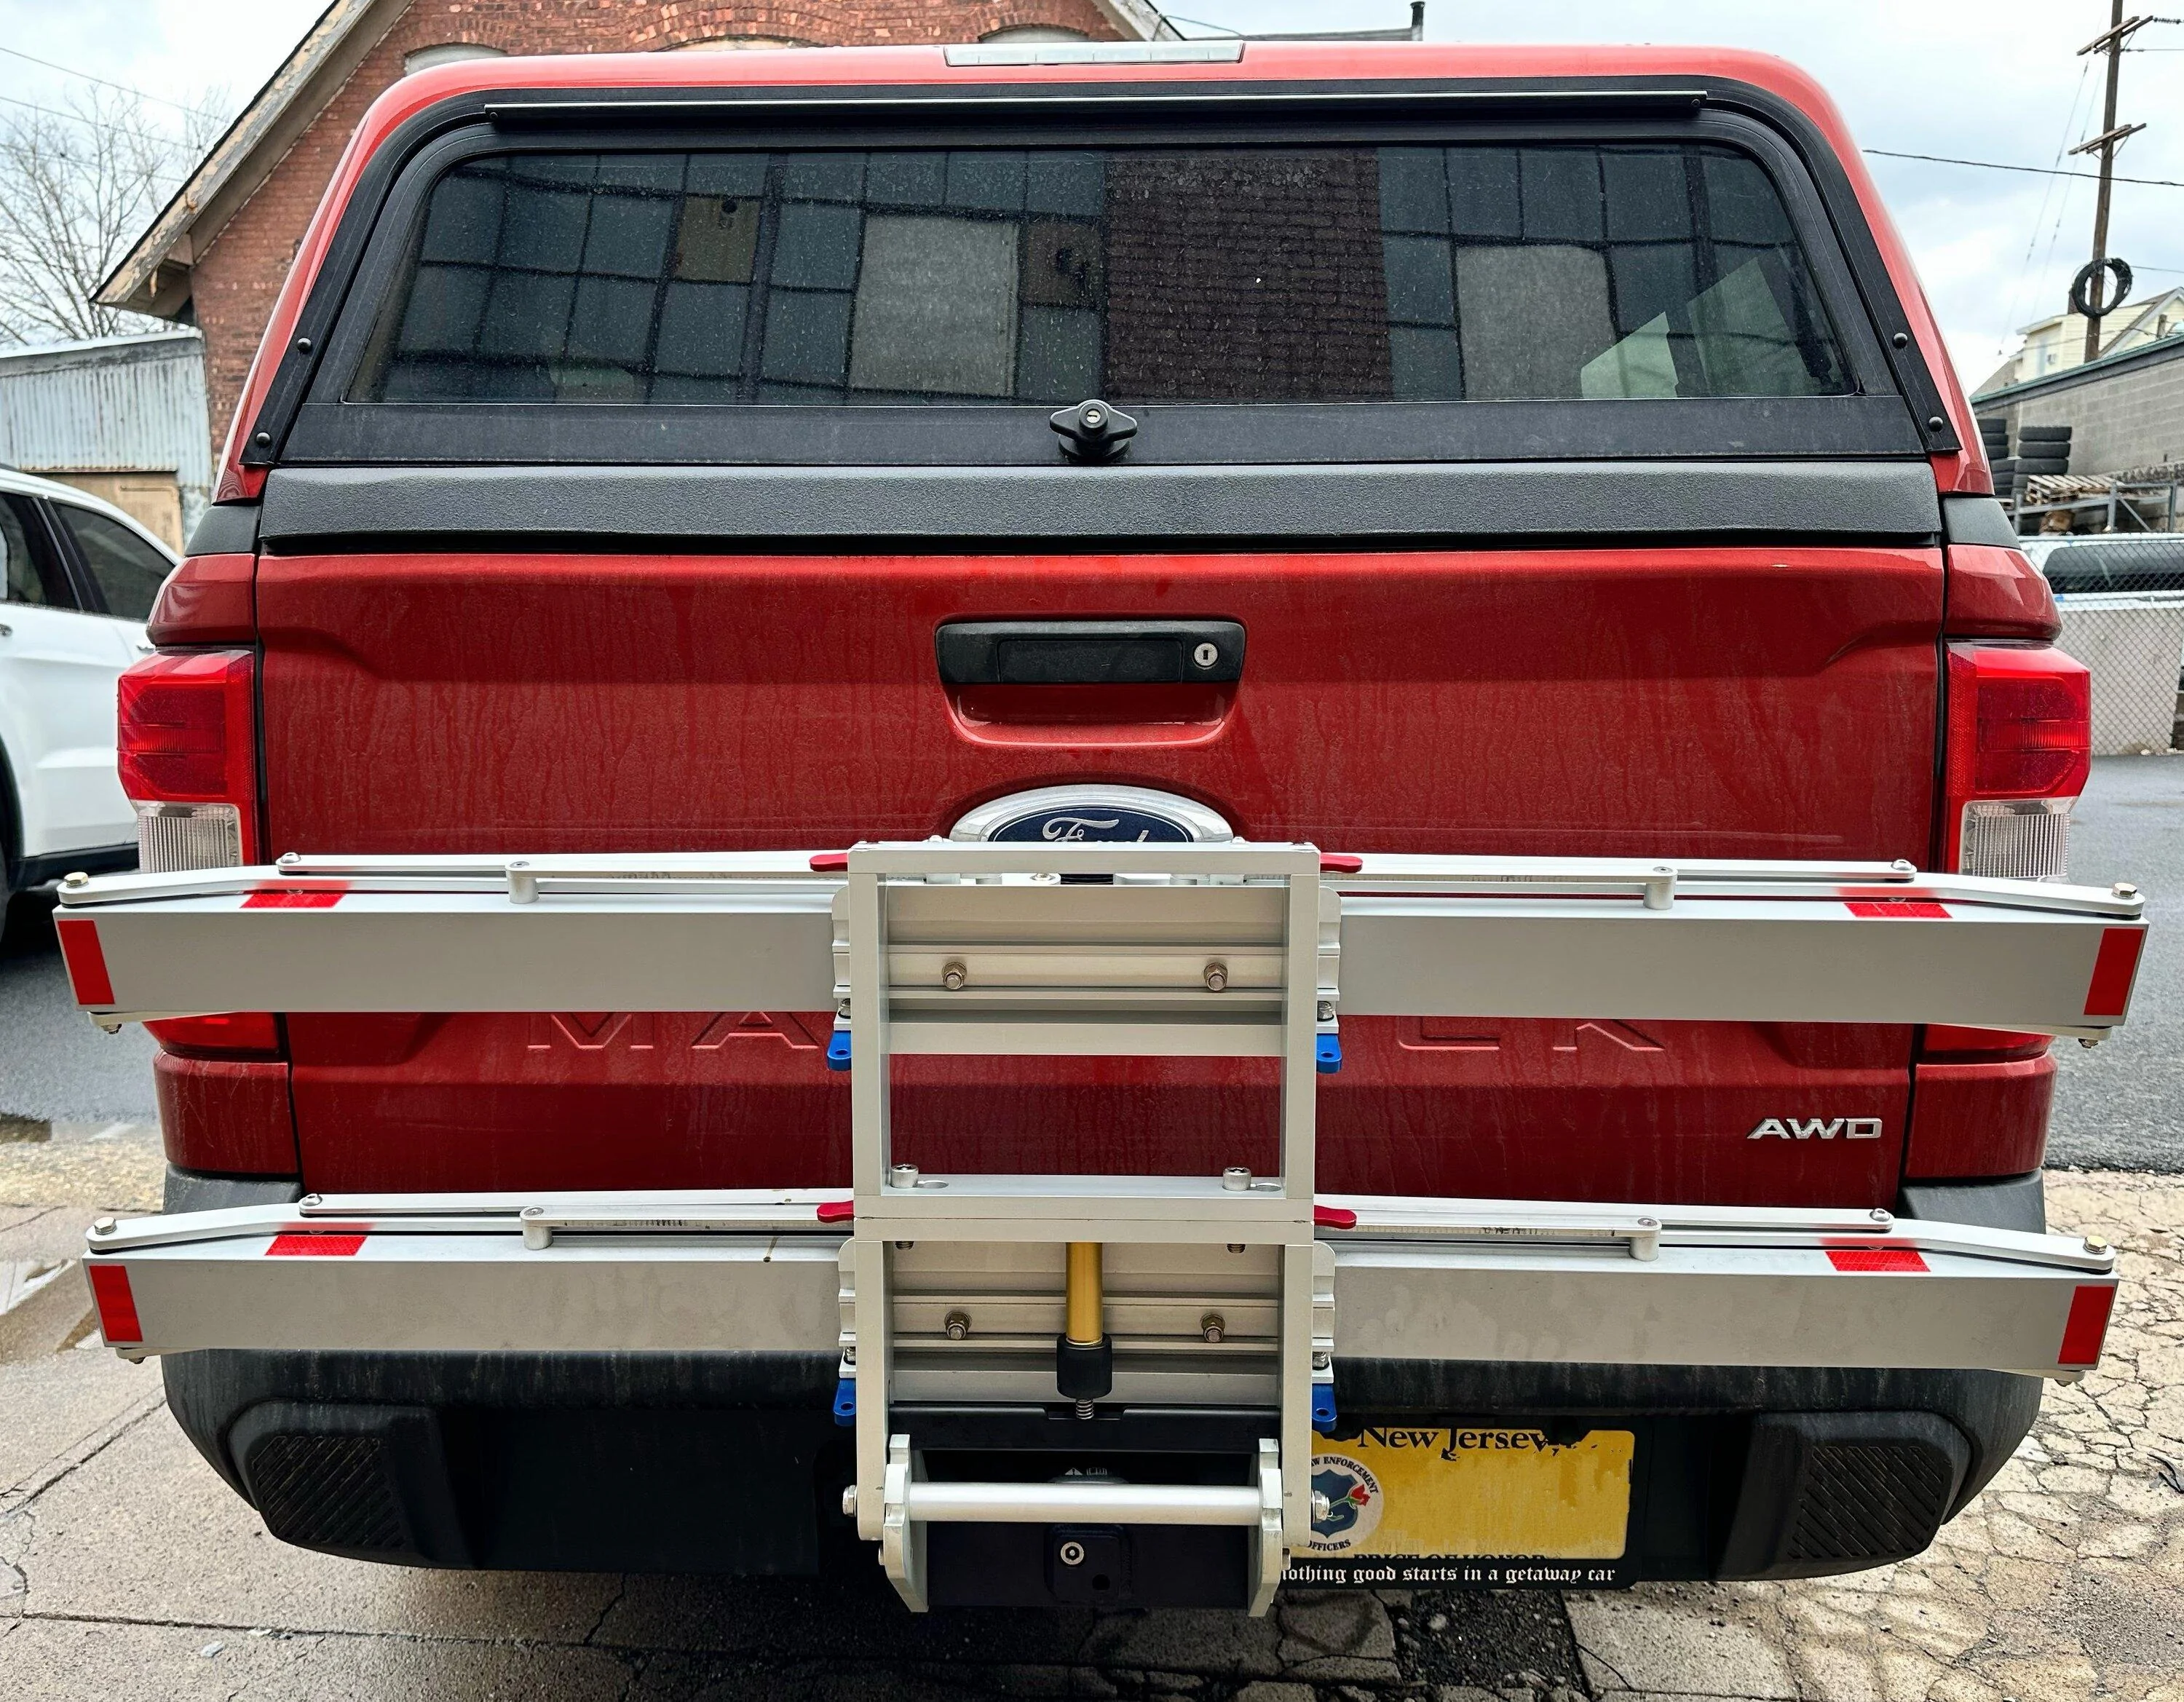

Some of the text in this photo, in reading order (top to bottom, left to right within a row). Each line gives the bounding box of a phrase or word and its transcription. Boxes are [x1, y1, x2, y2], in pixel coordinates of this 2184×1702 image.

[1748, 1117, 1883, 1139] AWD
[1357, 1428, 1439, 1449] New
[1324, 1457, 1378, 1493] ENFORCEMENT
[1353, 1565, 1396, 1584] good
[1402, 1567, 1457, 1581] starts
[1464, 1565, 1481, 1581] in
[1488, 1569, 1498, 1581] a
[1505, 1567, 1581, 1584] getaway
[1588, 1569, 1615, 1581] car
